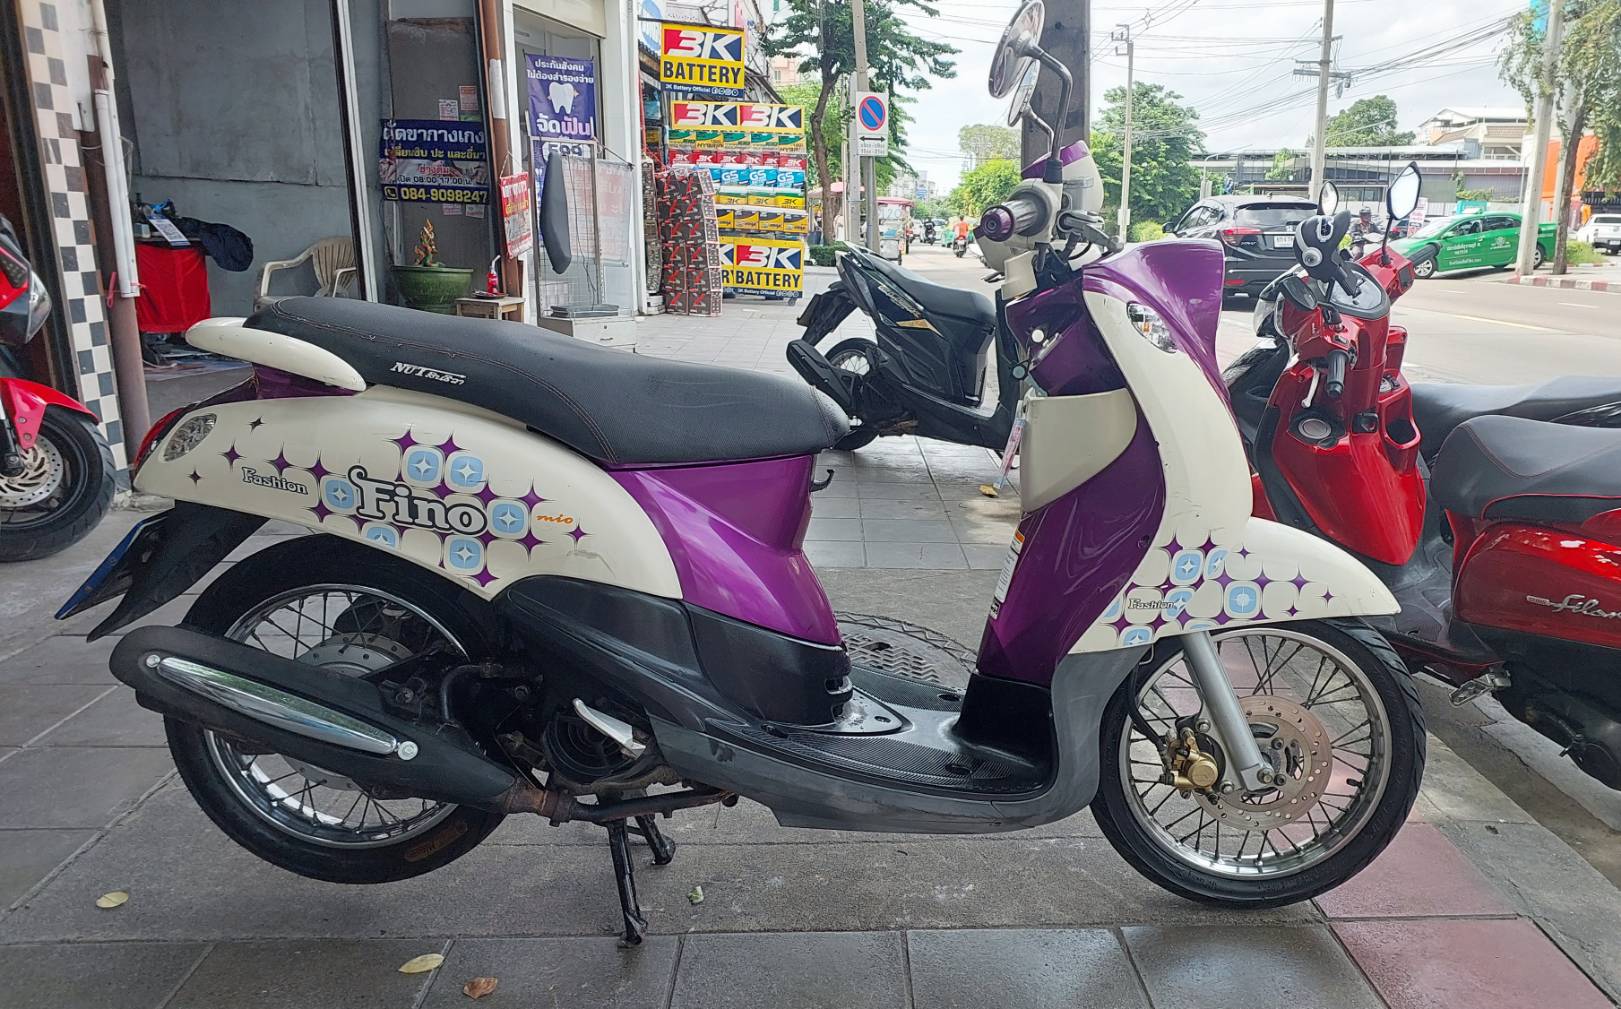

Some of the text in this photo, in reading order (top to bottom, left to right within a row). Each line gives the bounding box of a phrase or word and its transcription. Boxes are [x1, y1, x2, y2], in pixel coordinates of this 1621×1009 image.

[667, 30, 741, 62] 3K
[535, 59, 584, 71] ประกันสังคม
[663, 61, 741, 84] BATTERY
[537, 113, 590, 136] จัดฟัน
[677, 104, 737, 126] 3K
[741, 105, 800, 128] 3K
[722, 170, 738, 180] GS
[750, 170, 766, 181] GS
[777, 172, 794, 182] GS
[401, 188, 487, 202] 084-9098247
[739, 246, 801, 270] 3K
[736, 270, 800, 287] BATTERY
[242, 466, 308, 495] Fashion
[348, 465, 487, 535] Fino
[536, 513, 573, 524] mio
[1128, 598, 1174, 609] Fashion
